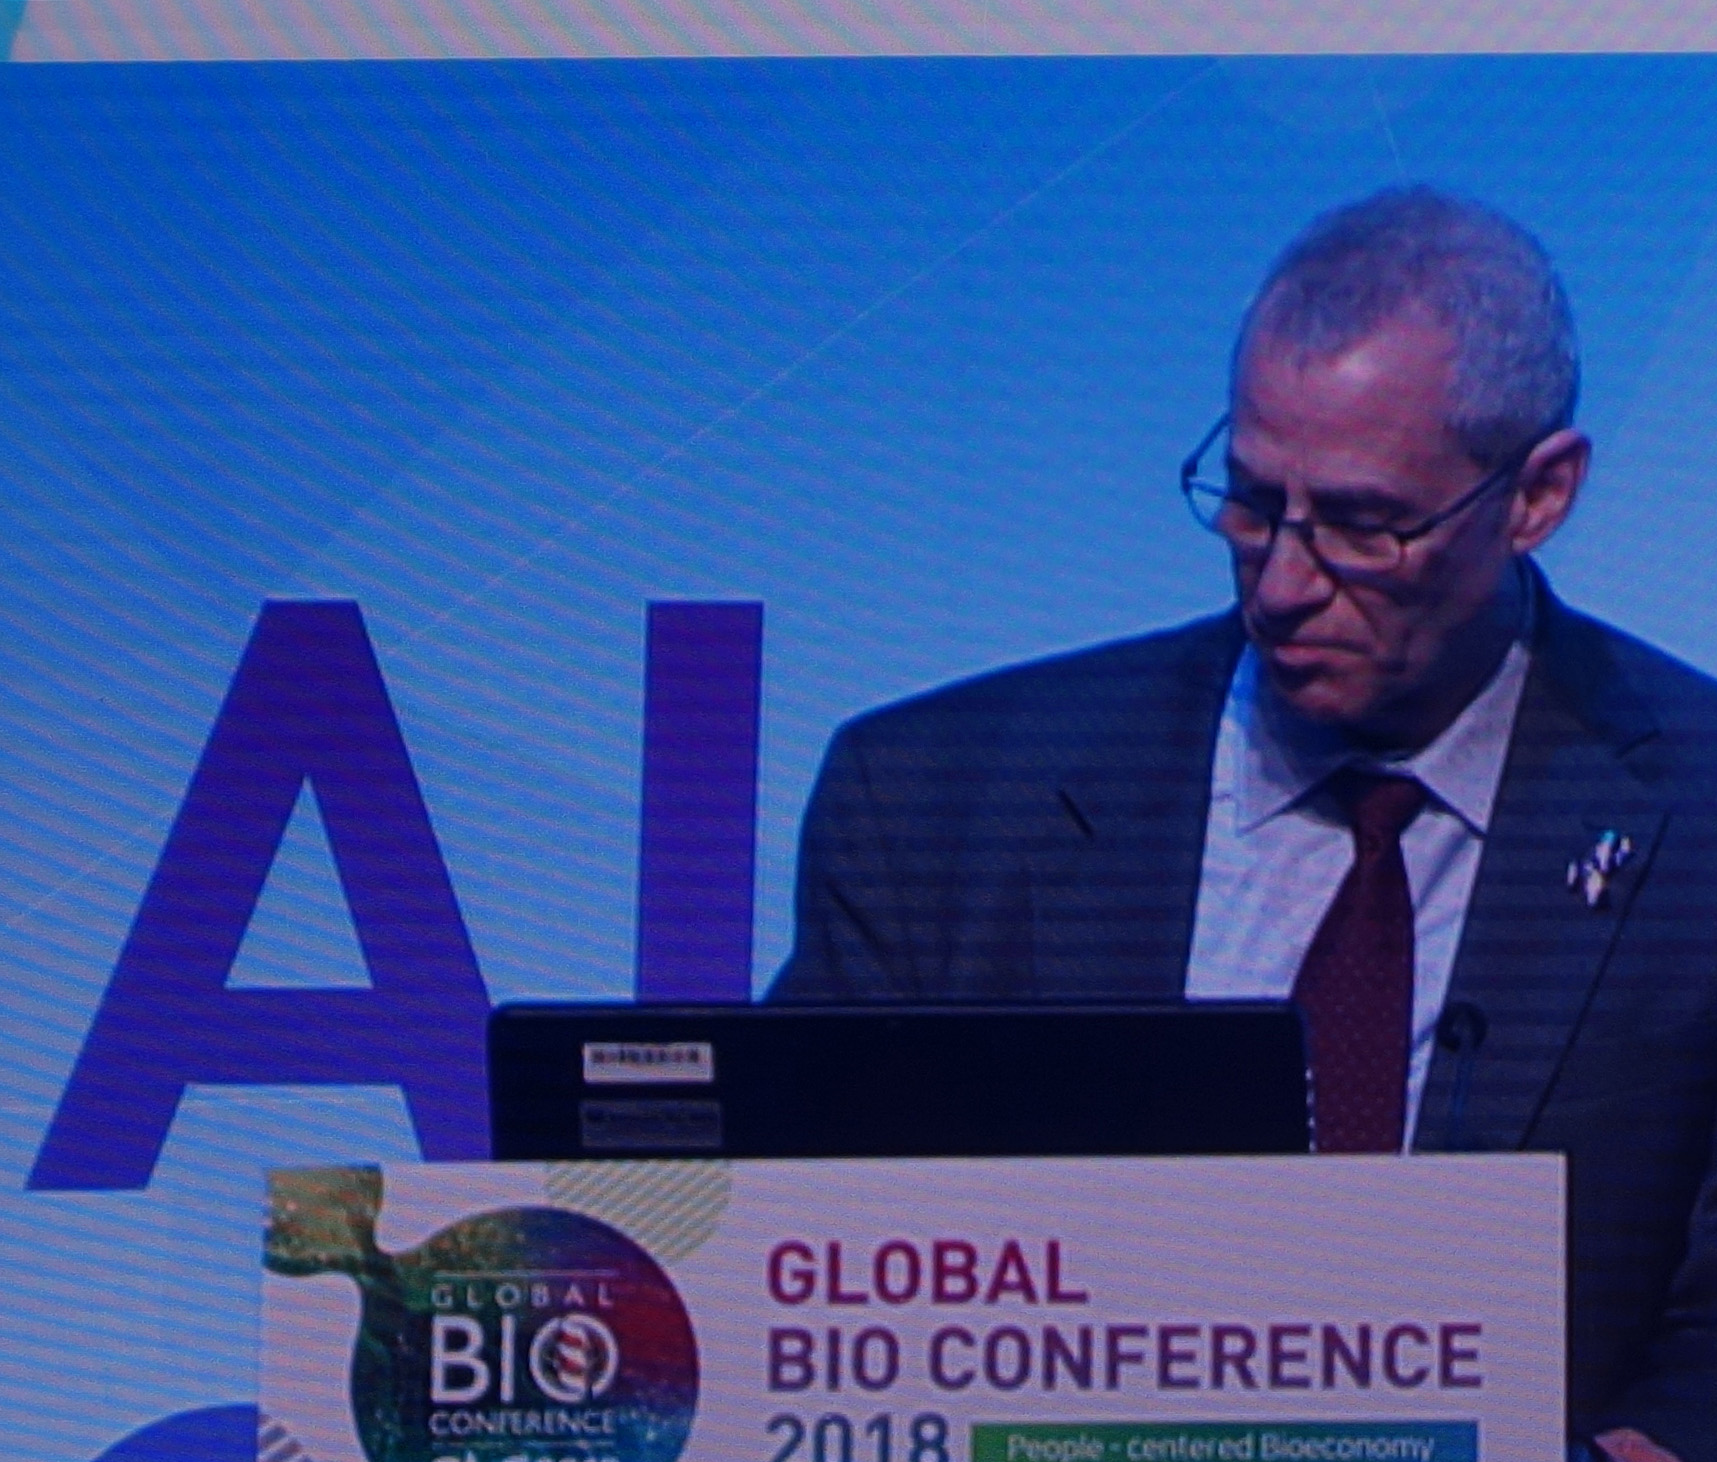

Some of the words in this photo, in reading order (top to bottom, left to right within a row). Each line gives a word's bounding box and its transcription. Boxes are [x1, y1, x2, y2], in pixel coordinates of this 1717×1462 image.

[431, 1282, 614, 1308] GLOBAL
[766, 1238, 1090, 1306] GLOBAL
[430, 1312, 619, 1404] BIO
[767, 1325, 900, 1393] BIO
[928, 1322, 1483, 1391] CONFERENCE
